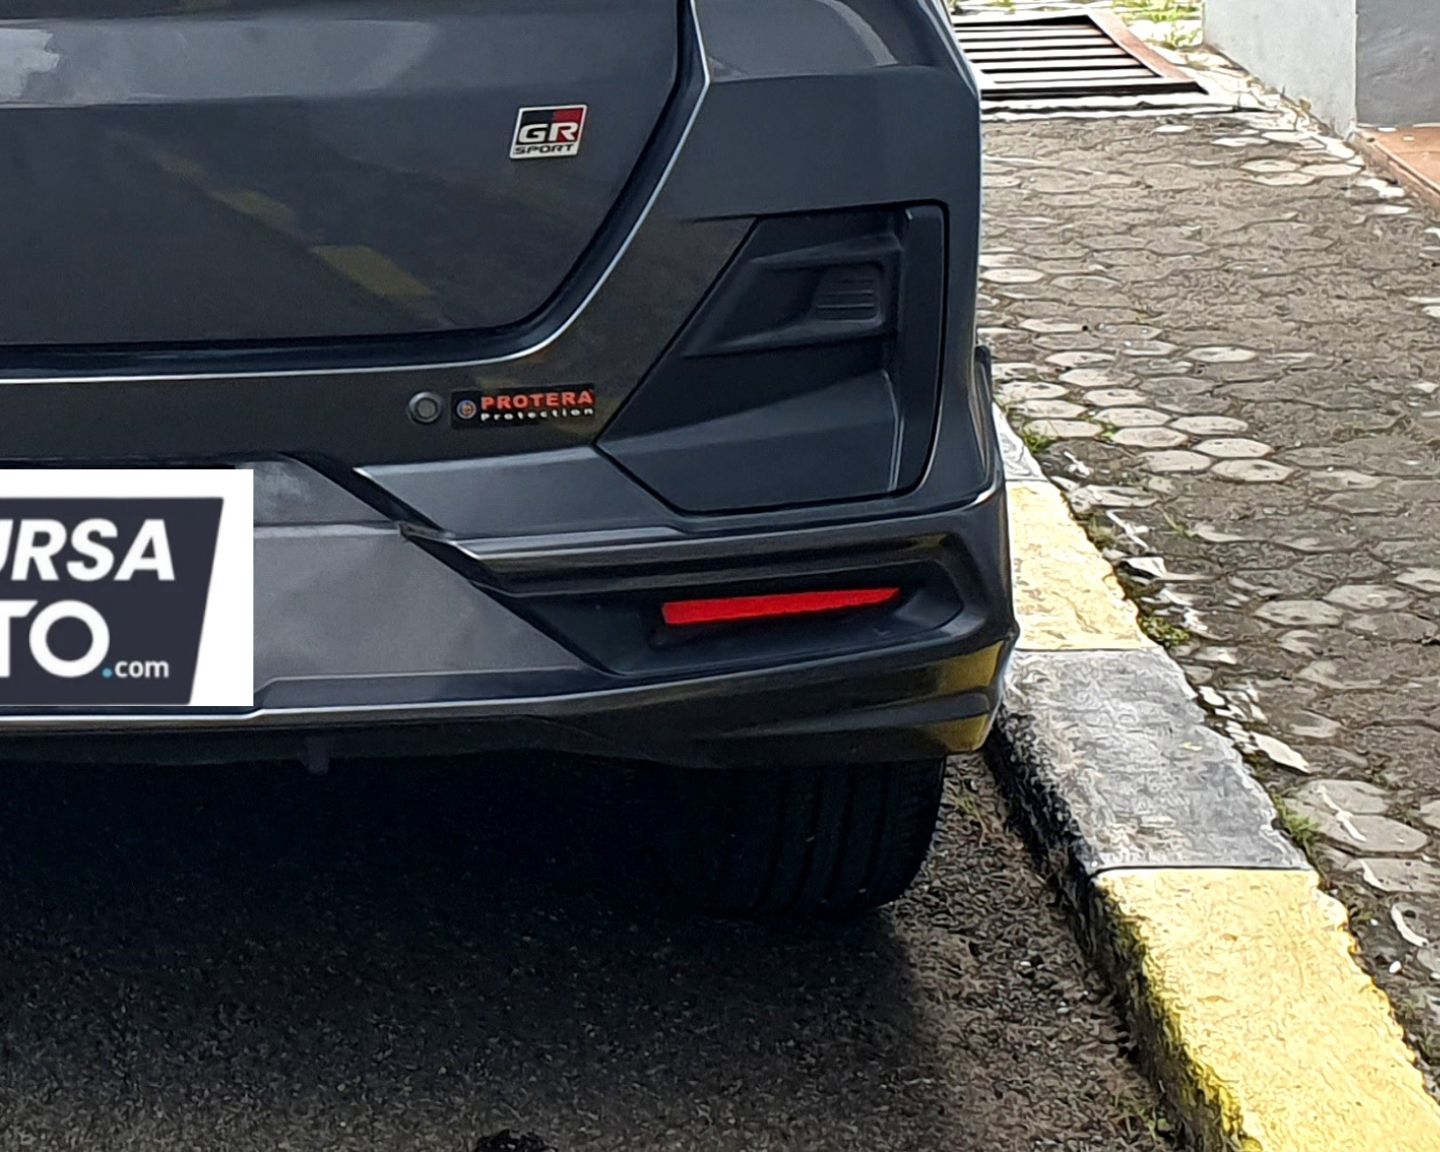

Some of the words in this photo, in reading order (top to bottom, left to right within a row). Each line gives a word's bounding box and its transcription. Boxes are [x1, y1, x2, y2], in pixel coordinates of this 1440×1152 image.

[518, 121, 579, 144] GR
[512, 144, 574, 155] SPORT
[480, 389, 594, 410] PROTERA
[480, 408, 594, 422] Protection
